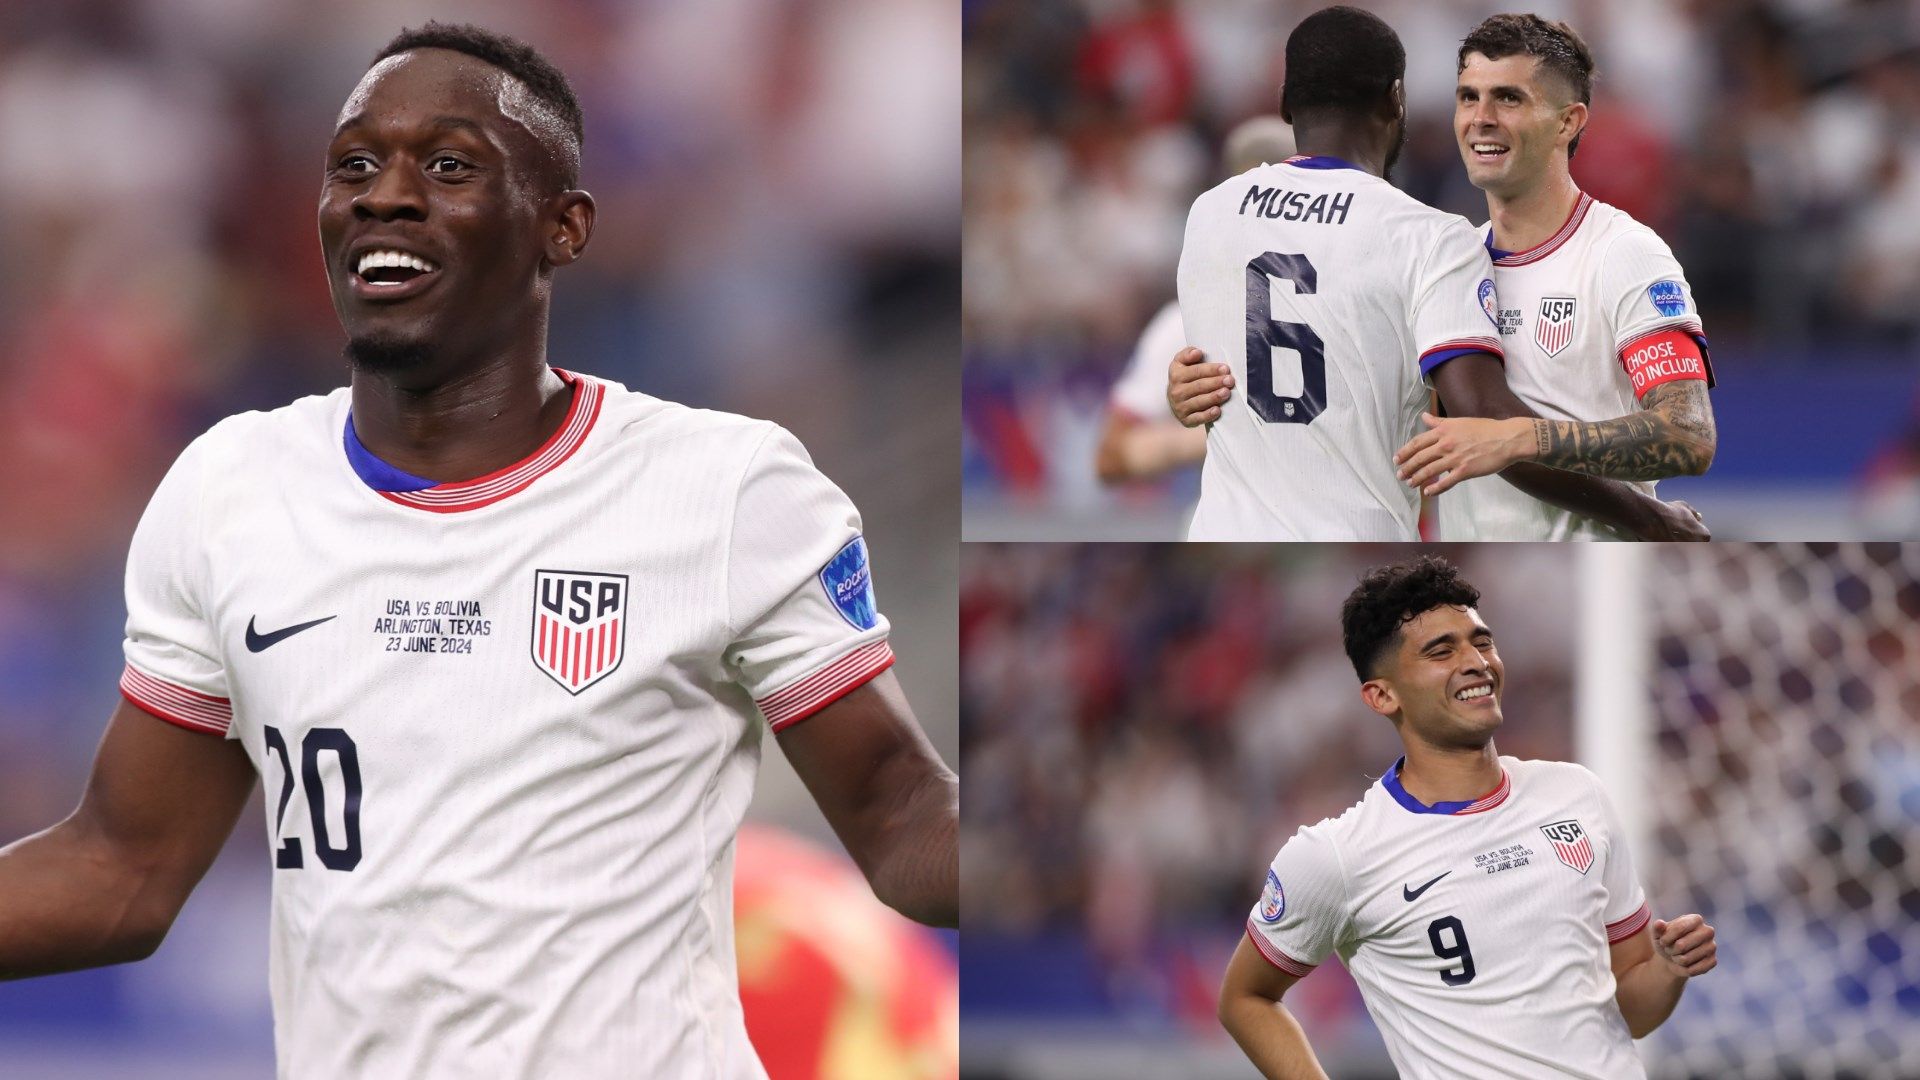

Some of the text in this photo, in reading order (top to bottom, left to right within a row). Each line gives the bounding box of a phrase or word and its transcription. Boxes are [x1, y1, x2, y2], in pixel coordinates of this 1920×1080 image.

[1239, 184, 1355, 225] MUSAH
[1542, 301, 1573, 323] USA
[1246, 251, 1327, 425] 6
[1627, 341, 1676, 374] CHOOSE
[1632, 357, 1700, 390] TO INCLUDE
[386, 599, 482, 617] USA VS. BOLIVIA
[542, 578, 620, 625] USA
[374, 618, 492, 636] ARLINGTON, TEXAS
[385, 637, 473, 654] 23 JUNE 2024
[264, 724, 363, 872] 20
[1545, 823, 1582, 843] USA
[1474, 854, 1488, 863] USA
[1498, 844, 1524, 856] BOLIVIA
[1513, 849, 1534, 859] TEXAS
[1486, 857, 1530, 874] 23 JUNE 2024
[1428, 915, 1476, 987] 9
